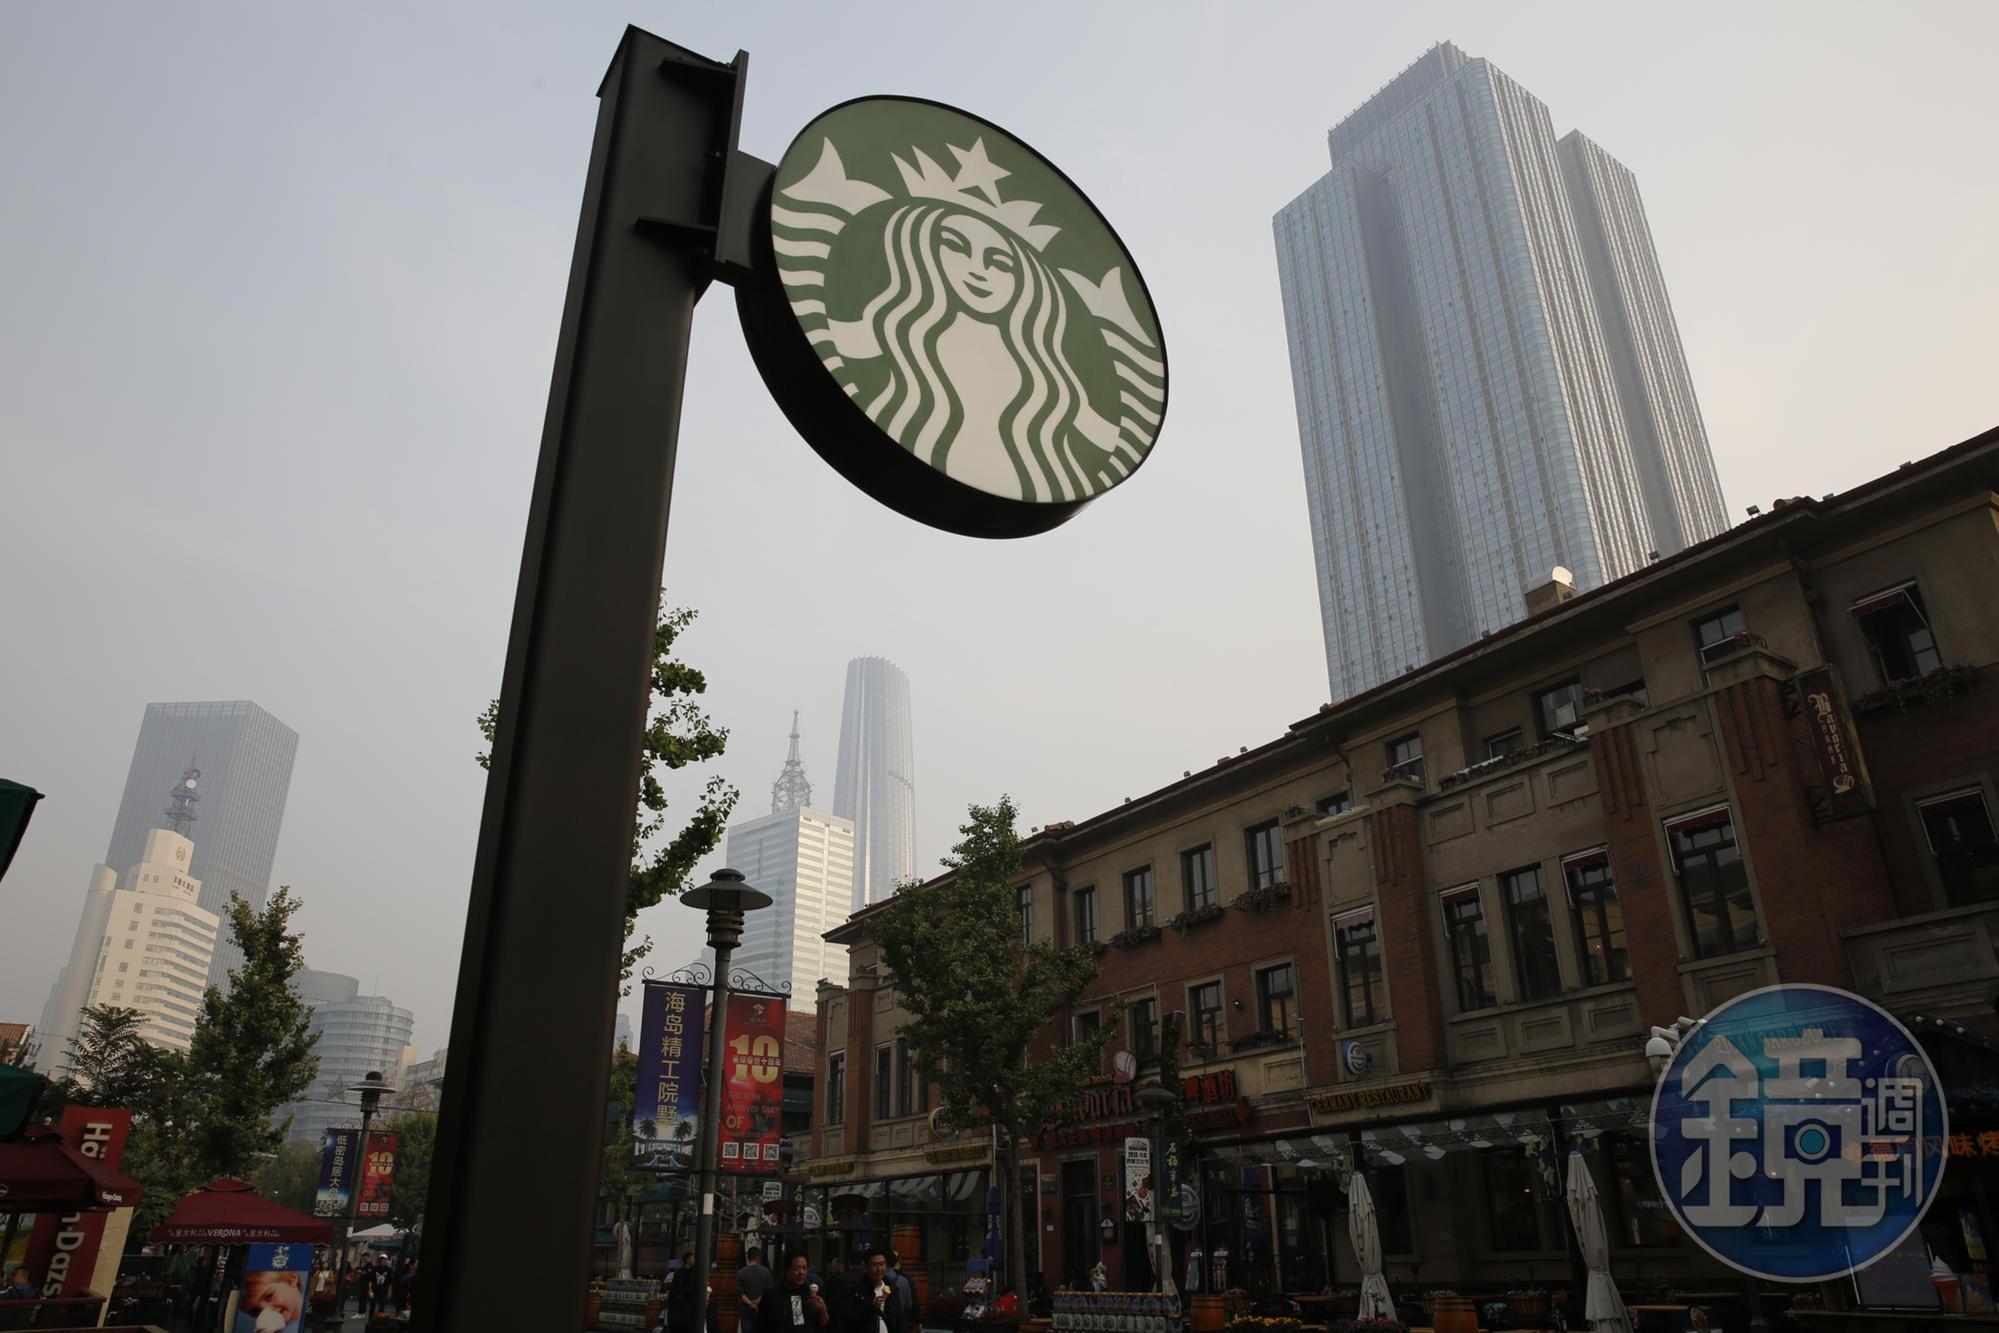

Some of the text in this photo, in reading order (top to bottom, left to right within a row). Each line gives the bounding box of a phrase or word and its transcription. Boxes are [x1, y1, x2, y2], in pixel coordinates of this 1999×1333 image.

[730, 1034, 779, 1084] 10
[726, 1115, 745, 1129] OF
[207, 1228, 241, 1238] VERONA
